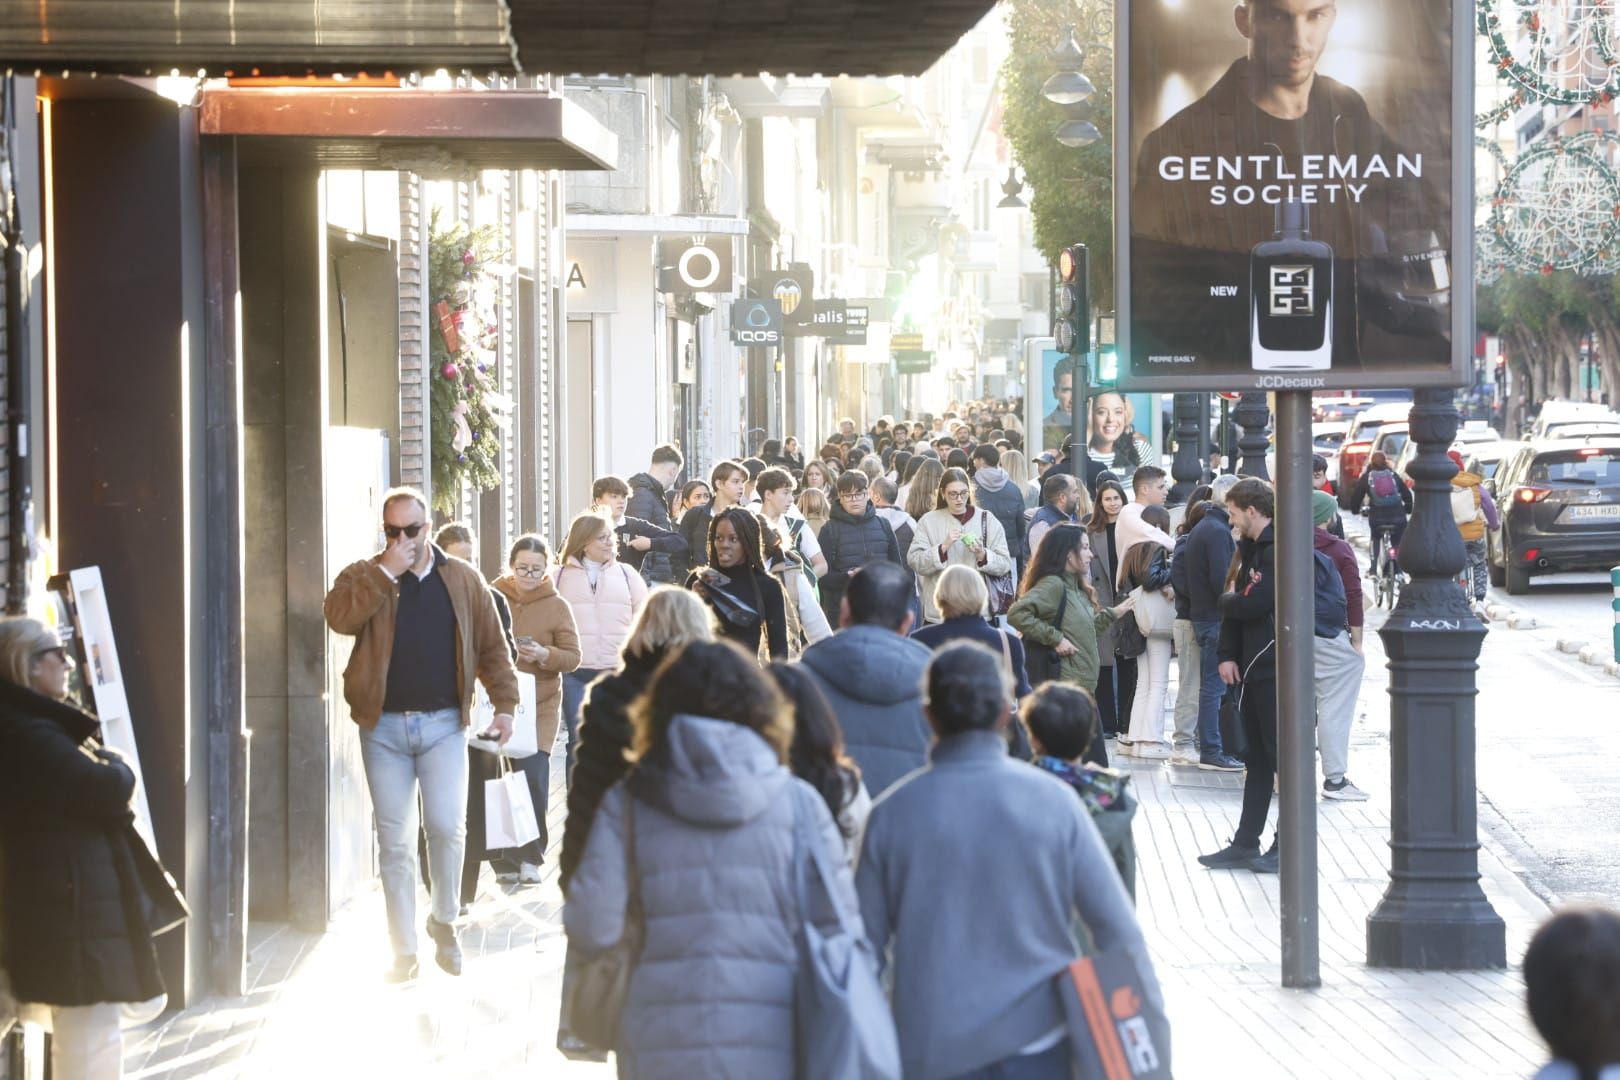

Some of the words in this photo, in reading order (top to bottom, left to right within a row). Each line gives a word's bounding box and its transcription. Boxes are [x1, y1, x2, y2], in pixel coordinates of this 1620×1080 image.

[1158, 153, 1422, 181] GENTLEMAN
[1210, 184, 1368, 205] SOCIETY
[566, 262, 586, 289] A
[1210, 285, 1238, 297] NEW
[737, 330, 778, 342] IQOS
[1148, 355, 1172, 363] PIERRE
[1173, 355, 1196, 363] GASLY
[1255, 375, 1325, 388] JCDecaux
